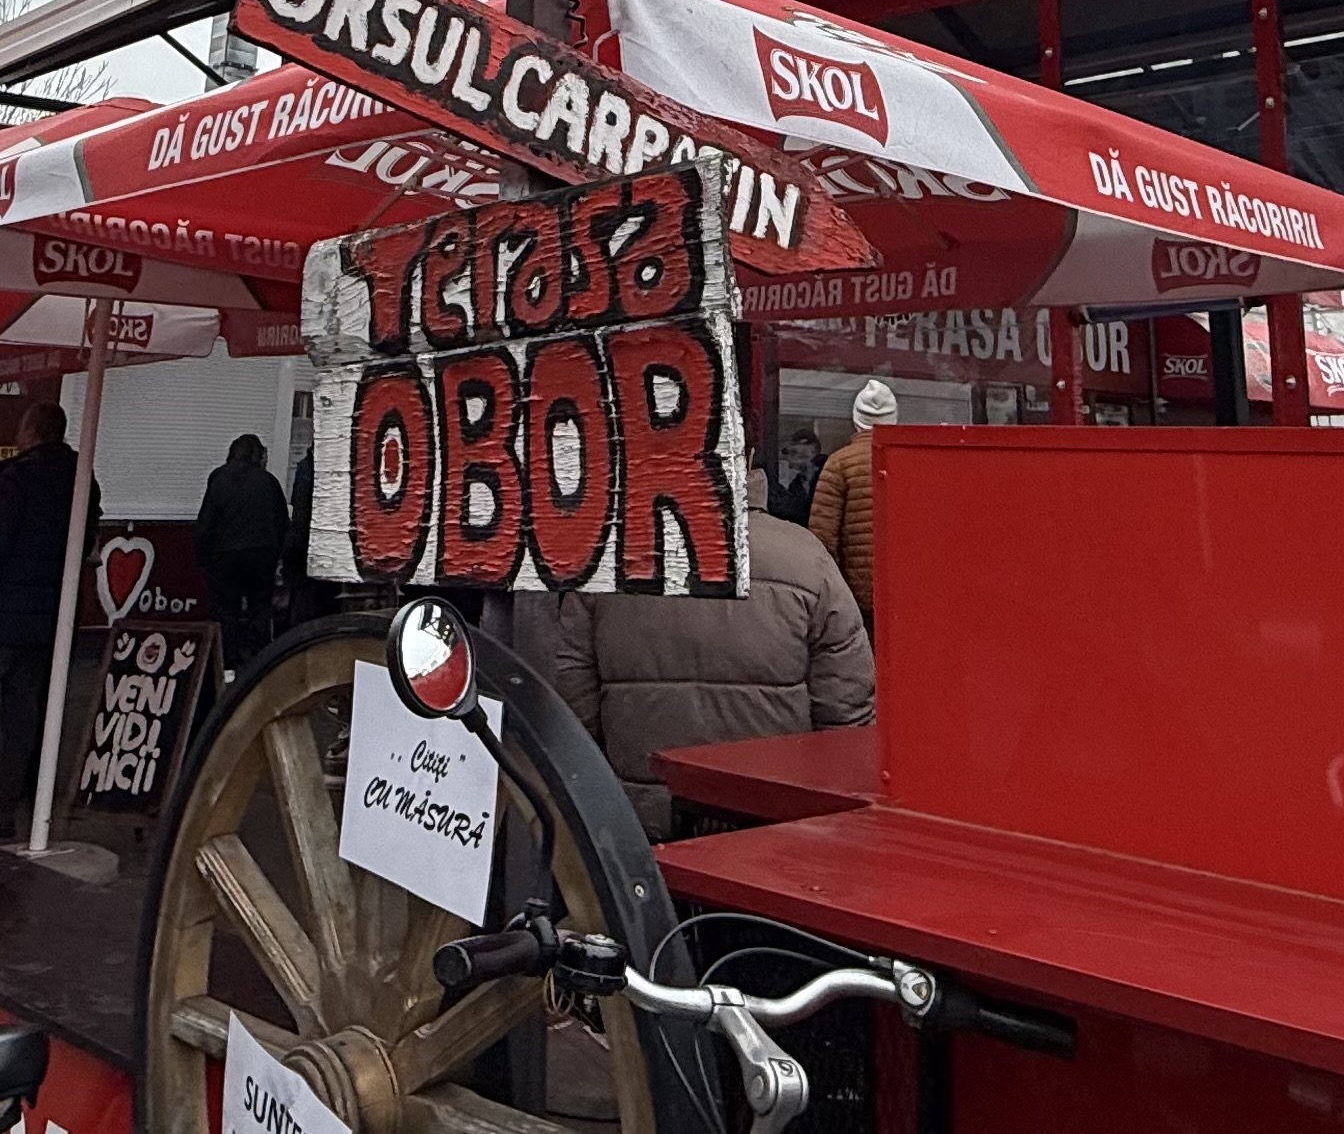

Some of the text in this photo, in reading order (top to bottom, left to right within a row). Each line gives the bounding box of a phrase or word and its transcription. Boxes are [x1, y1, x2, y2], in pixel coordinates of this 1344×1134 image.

[770, 47, 880, 121] SKOL
[148, 76, 396, 171] DĂ GUST RĂCOR
[501, 54, 801, 248] CARPIN
[1088, 147, 1325, 250] DĂ GUST RĂCORIRII
[38, 240, 134, 277] SKOL
[1036, 308, 1131, 375] OOR
[1163, 357, 1208, 376] SKOL
[351, 325, 734, 590] OBOR
[139, 586, 197, 613] obor
[106, 673, 177, 716] VENI
[363, 776, 393, 810] CU
